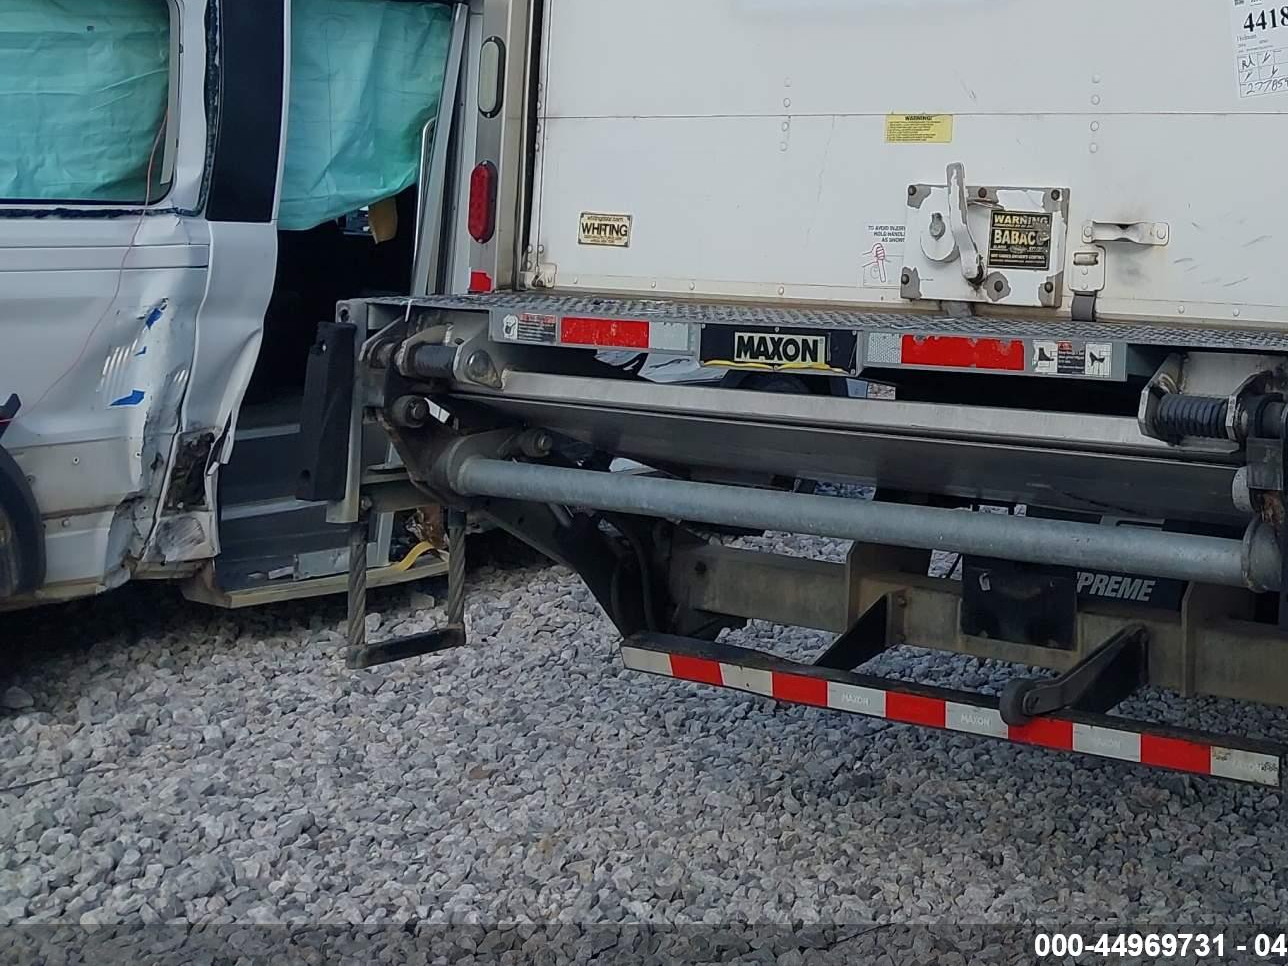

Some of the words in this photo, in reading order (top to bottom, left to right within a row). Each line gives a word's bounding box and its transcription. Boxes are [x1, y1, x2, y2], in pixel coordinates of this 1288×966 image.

[582, 222, 628, 237] WHITING
[994, 214, 1048, 224] WARNING
[736, 335, 819, 363] MAXON
[1076, 571, 1156, 602] PREME
